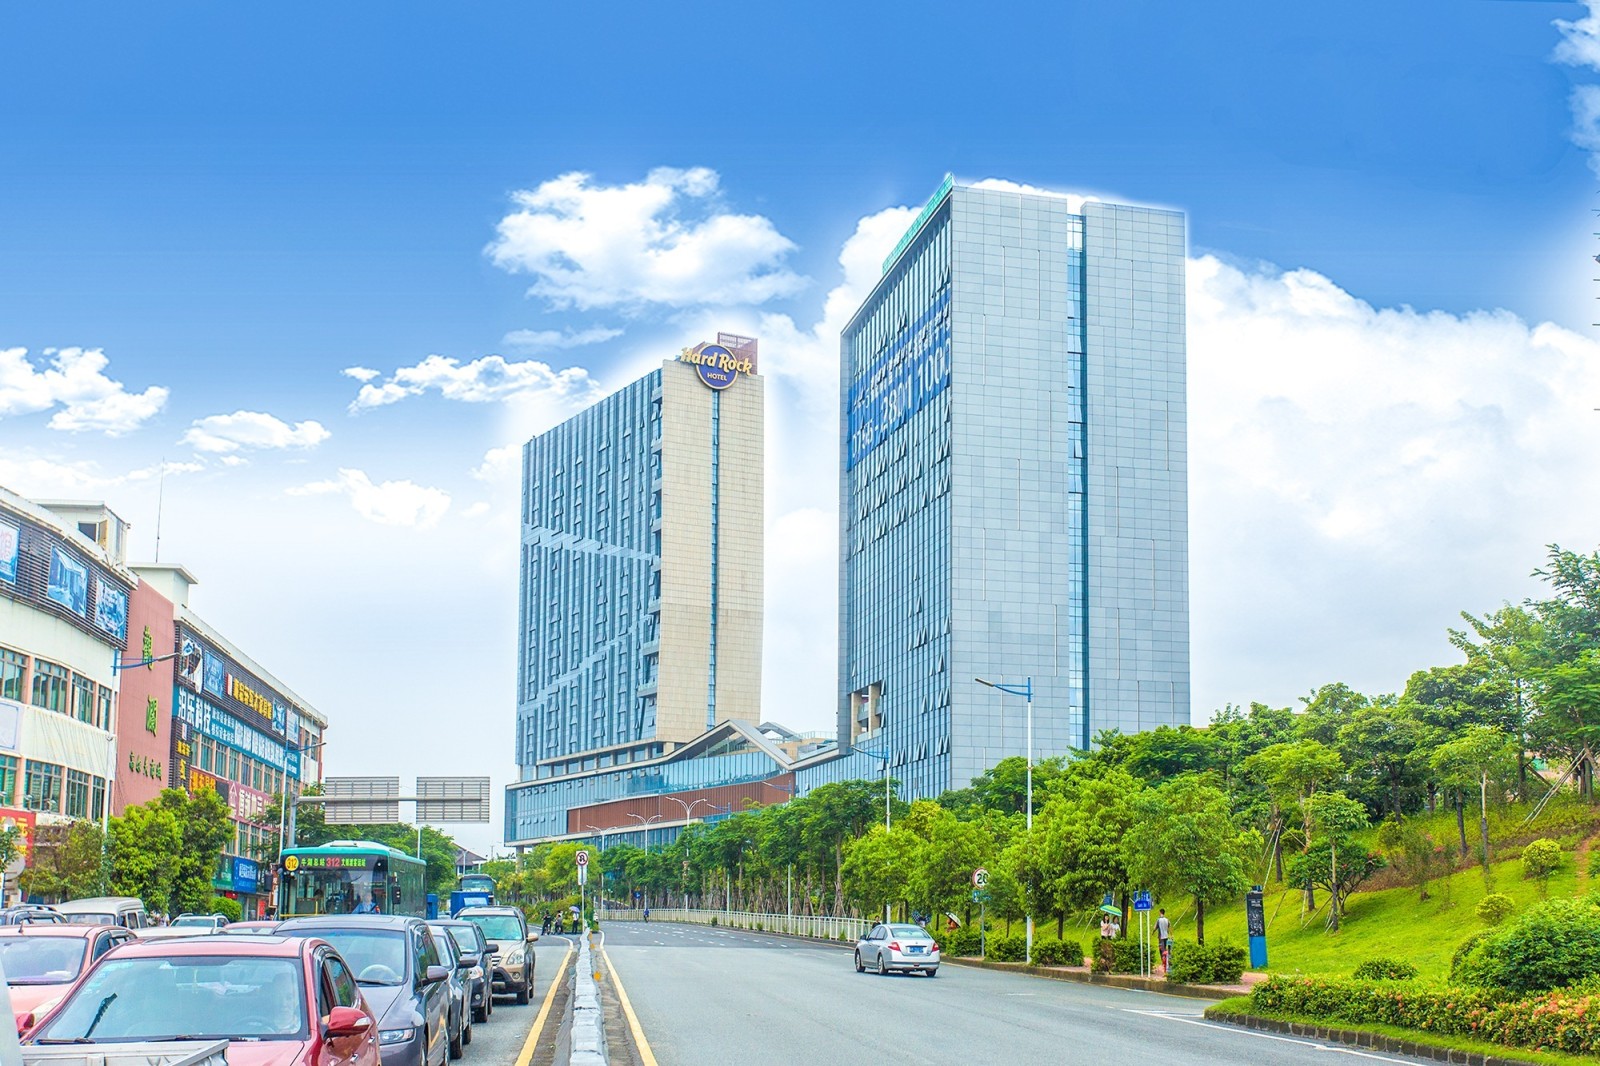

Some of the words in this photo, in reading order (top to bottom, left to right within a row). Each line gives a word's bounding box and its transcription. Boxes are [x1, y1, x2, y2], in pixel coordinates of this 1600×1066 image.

[680, 348, 718, 367] Hard
[718, 354, 753, 376] Rock
[707, 372, 727, 381] HOTEL
[287, 857, 298, 869] 312
[326, 857, 340, 867] 312
